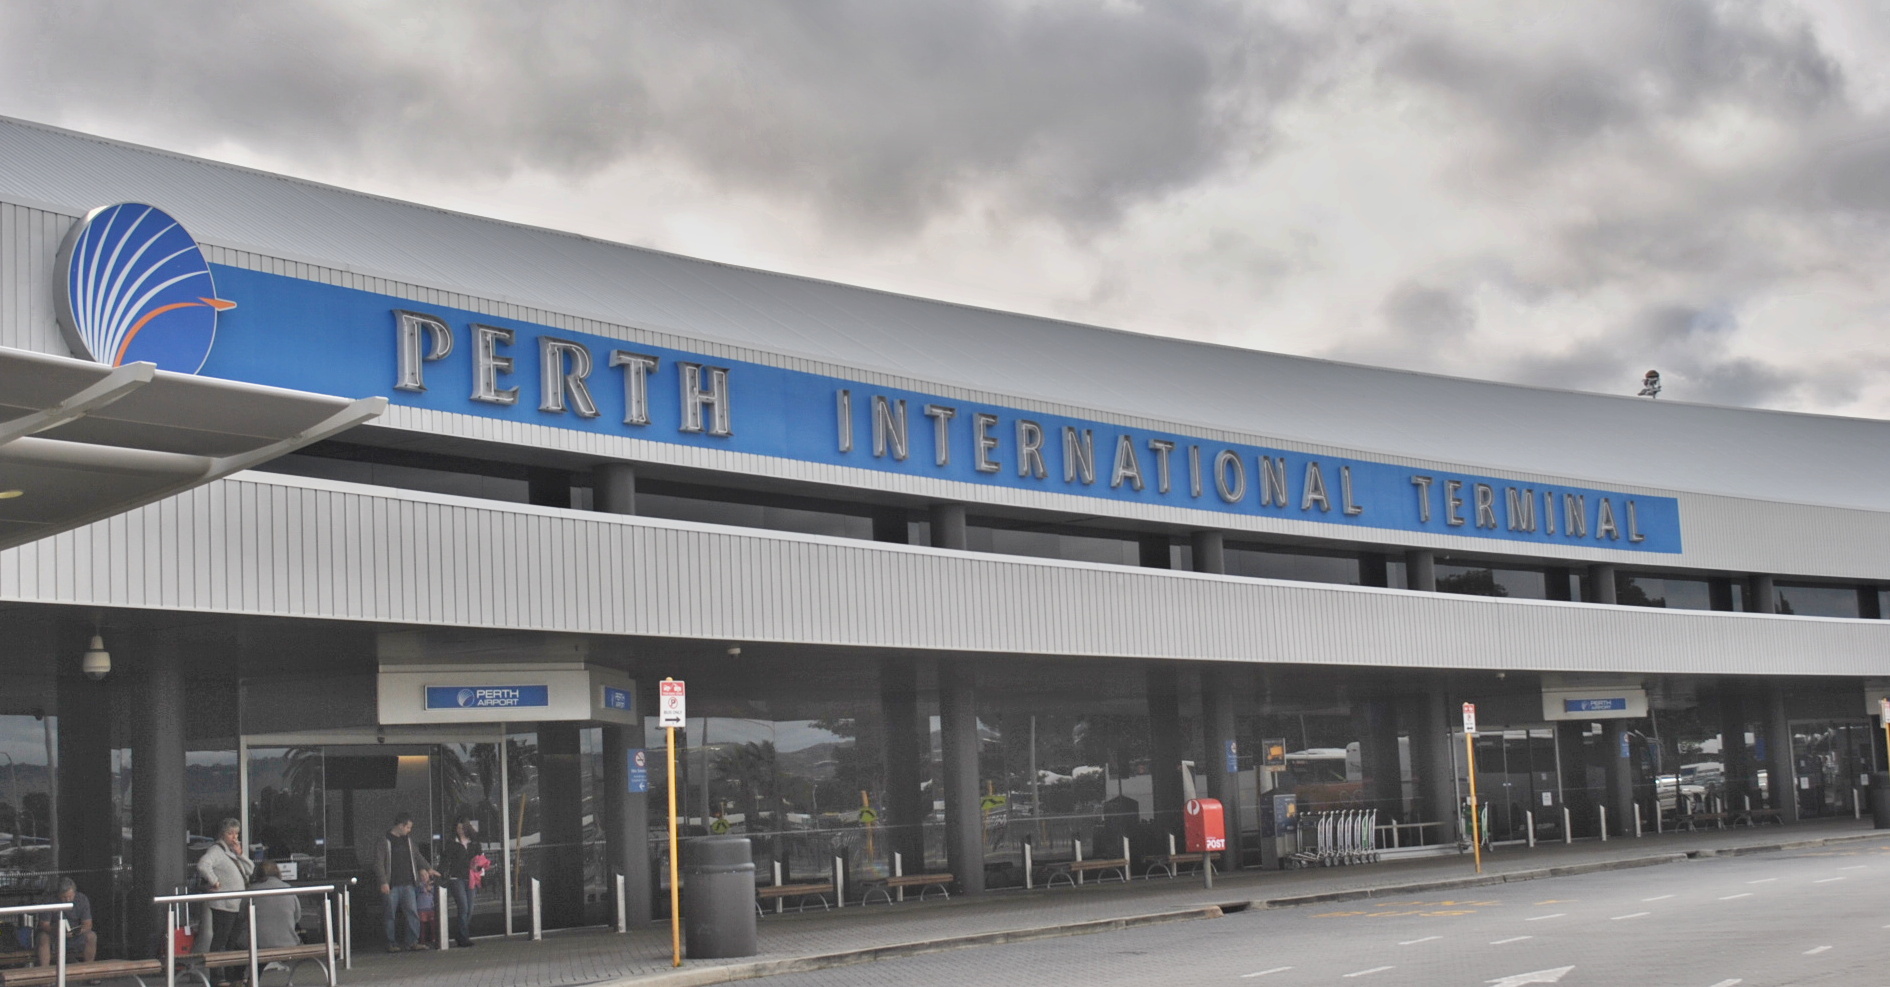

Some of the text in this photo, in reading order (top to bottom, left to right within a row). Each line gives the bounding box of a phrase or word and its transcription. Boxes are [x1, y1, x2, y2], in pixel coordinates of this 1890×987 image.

[392, 308, 1647, 543] PERTH INTERNATIONAL TERMINAL
[476, 689, 519, 699] PERTH
[1206, 838, 1226, 849] POST
